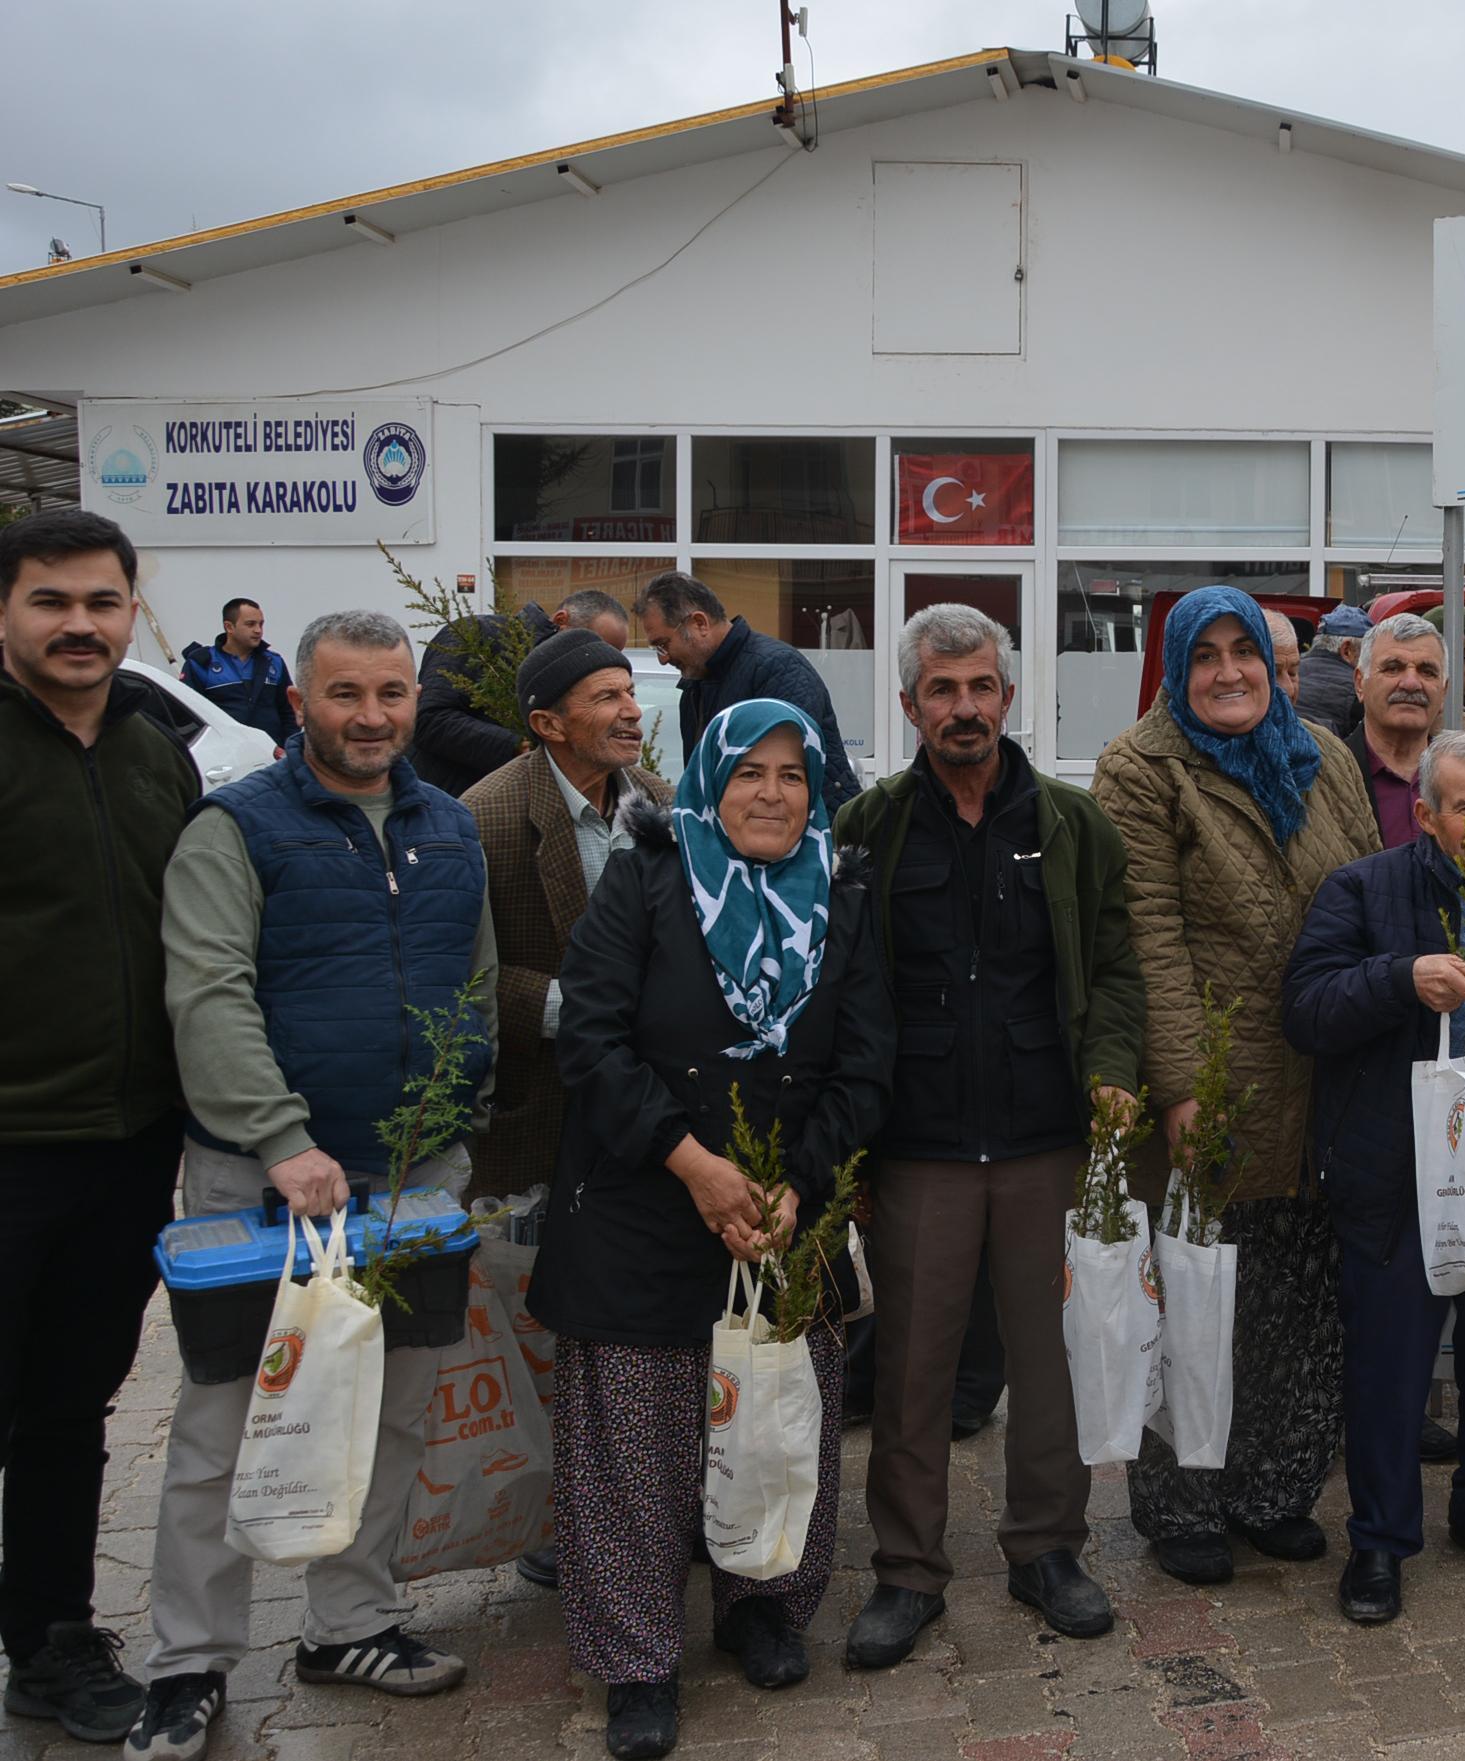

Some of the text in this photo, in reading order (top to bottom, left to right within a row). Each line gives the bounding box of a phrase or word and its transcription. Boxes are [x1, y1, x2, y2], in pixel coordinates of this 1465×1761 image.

[165, 412, 258, 454] KORKUTELİ
[263, 411, 355, 453] BELEDİYESİ
[378, 426, 411, 440] ZABITA
[166, 480, 357, 515] ZABITA KARAKOLU
[433, 1372, 502, 1424] LO
